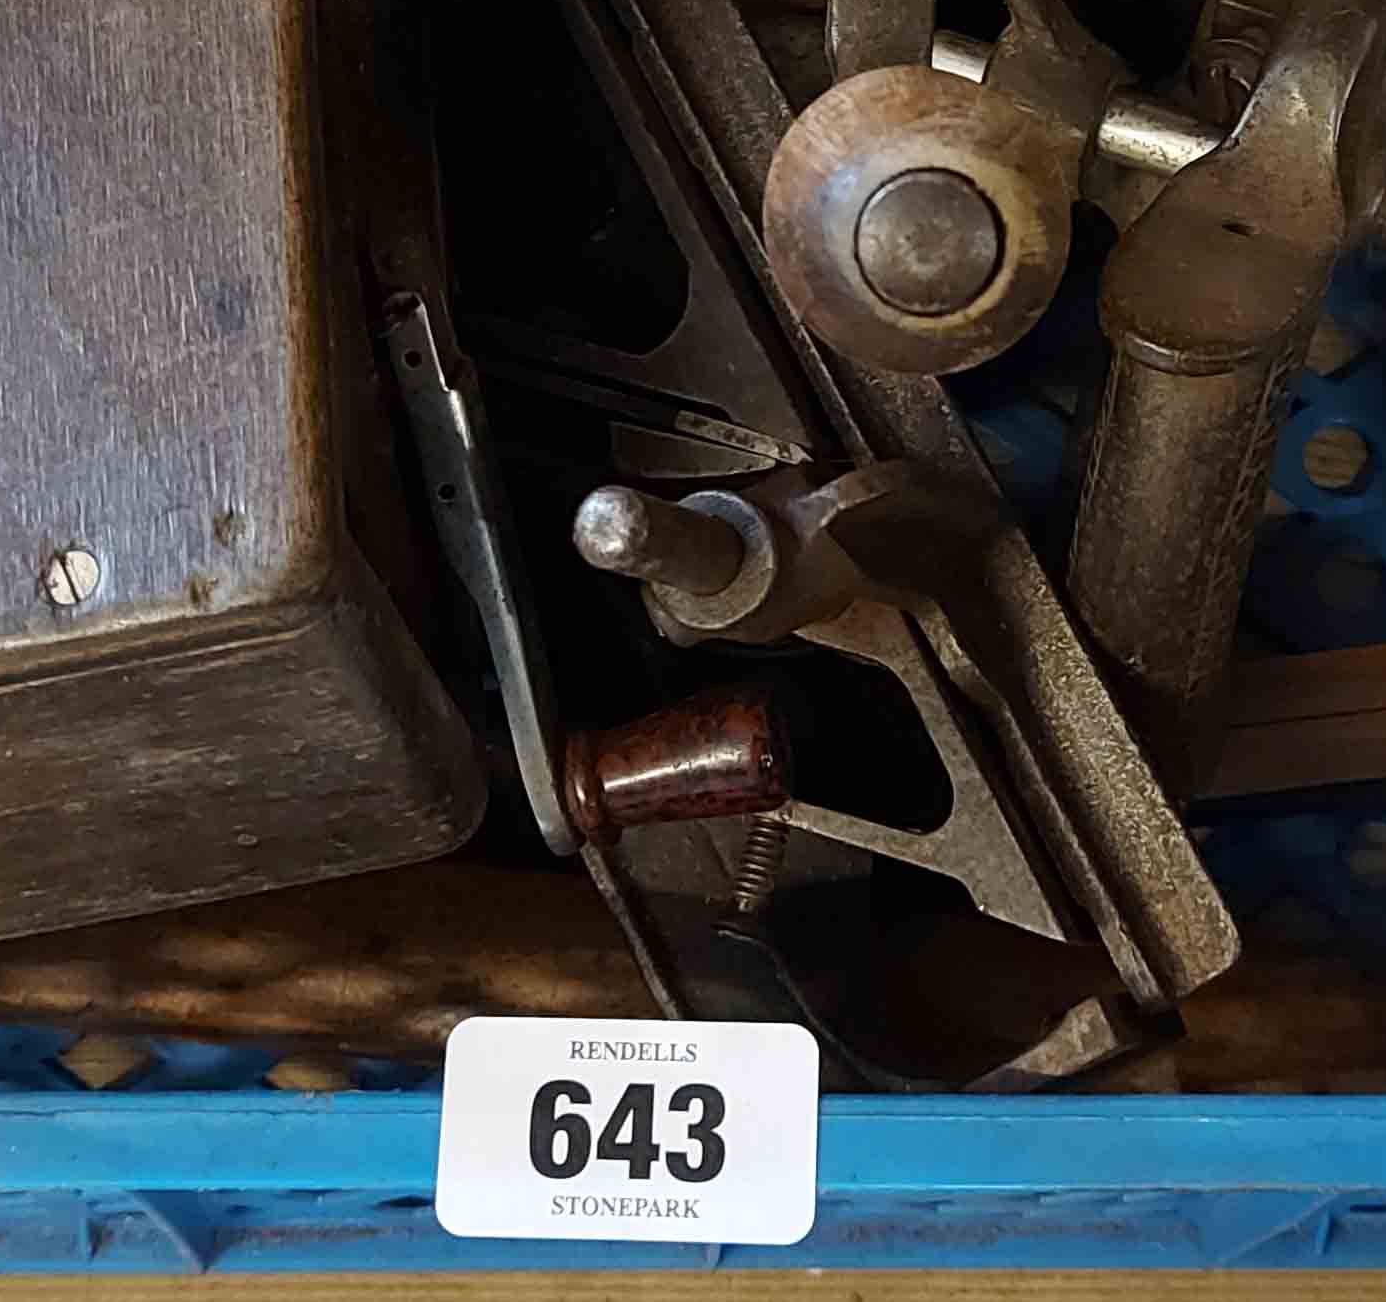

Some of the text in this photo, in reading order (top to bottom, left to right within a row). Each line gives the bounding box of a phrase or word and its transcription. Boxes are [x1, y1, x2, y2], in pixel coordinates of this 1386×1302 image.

[568, 1039, 699, 1064] RENDELLS
[528, 1079, 726, 1183] 643
[550, 1195, 700, 1219] STONEPARK
